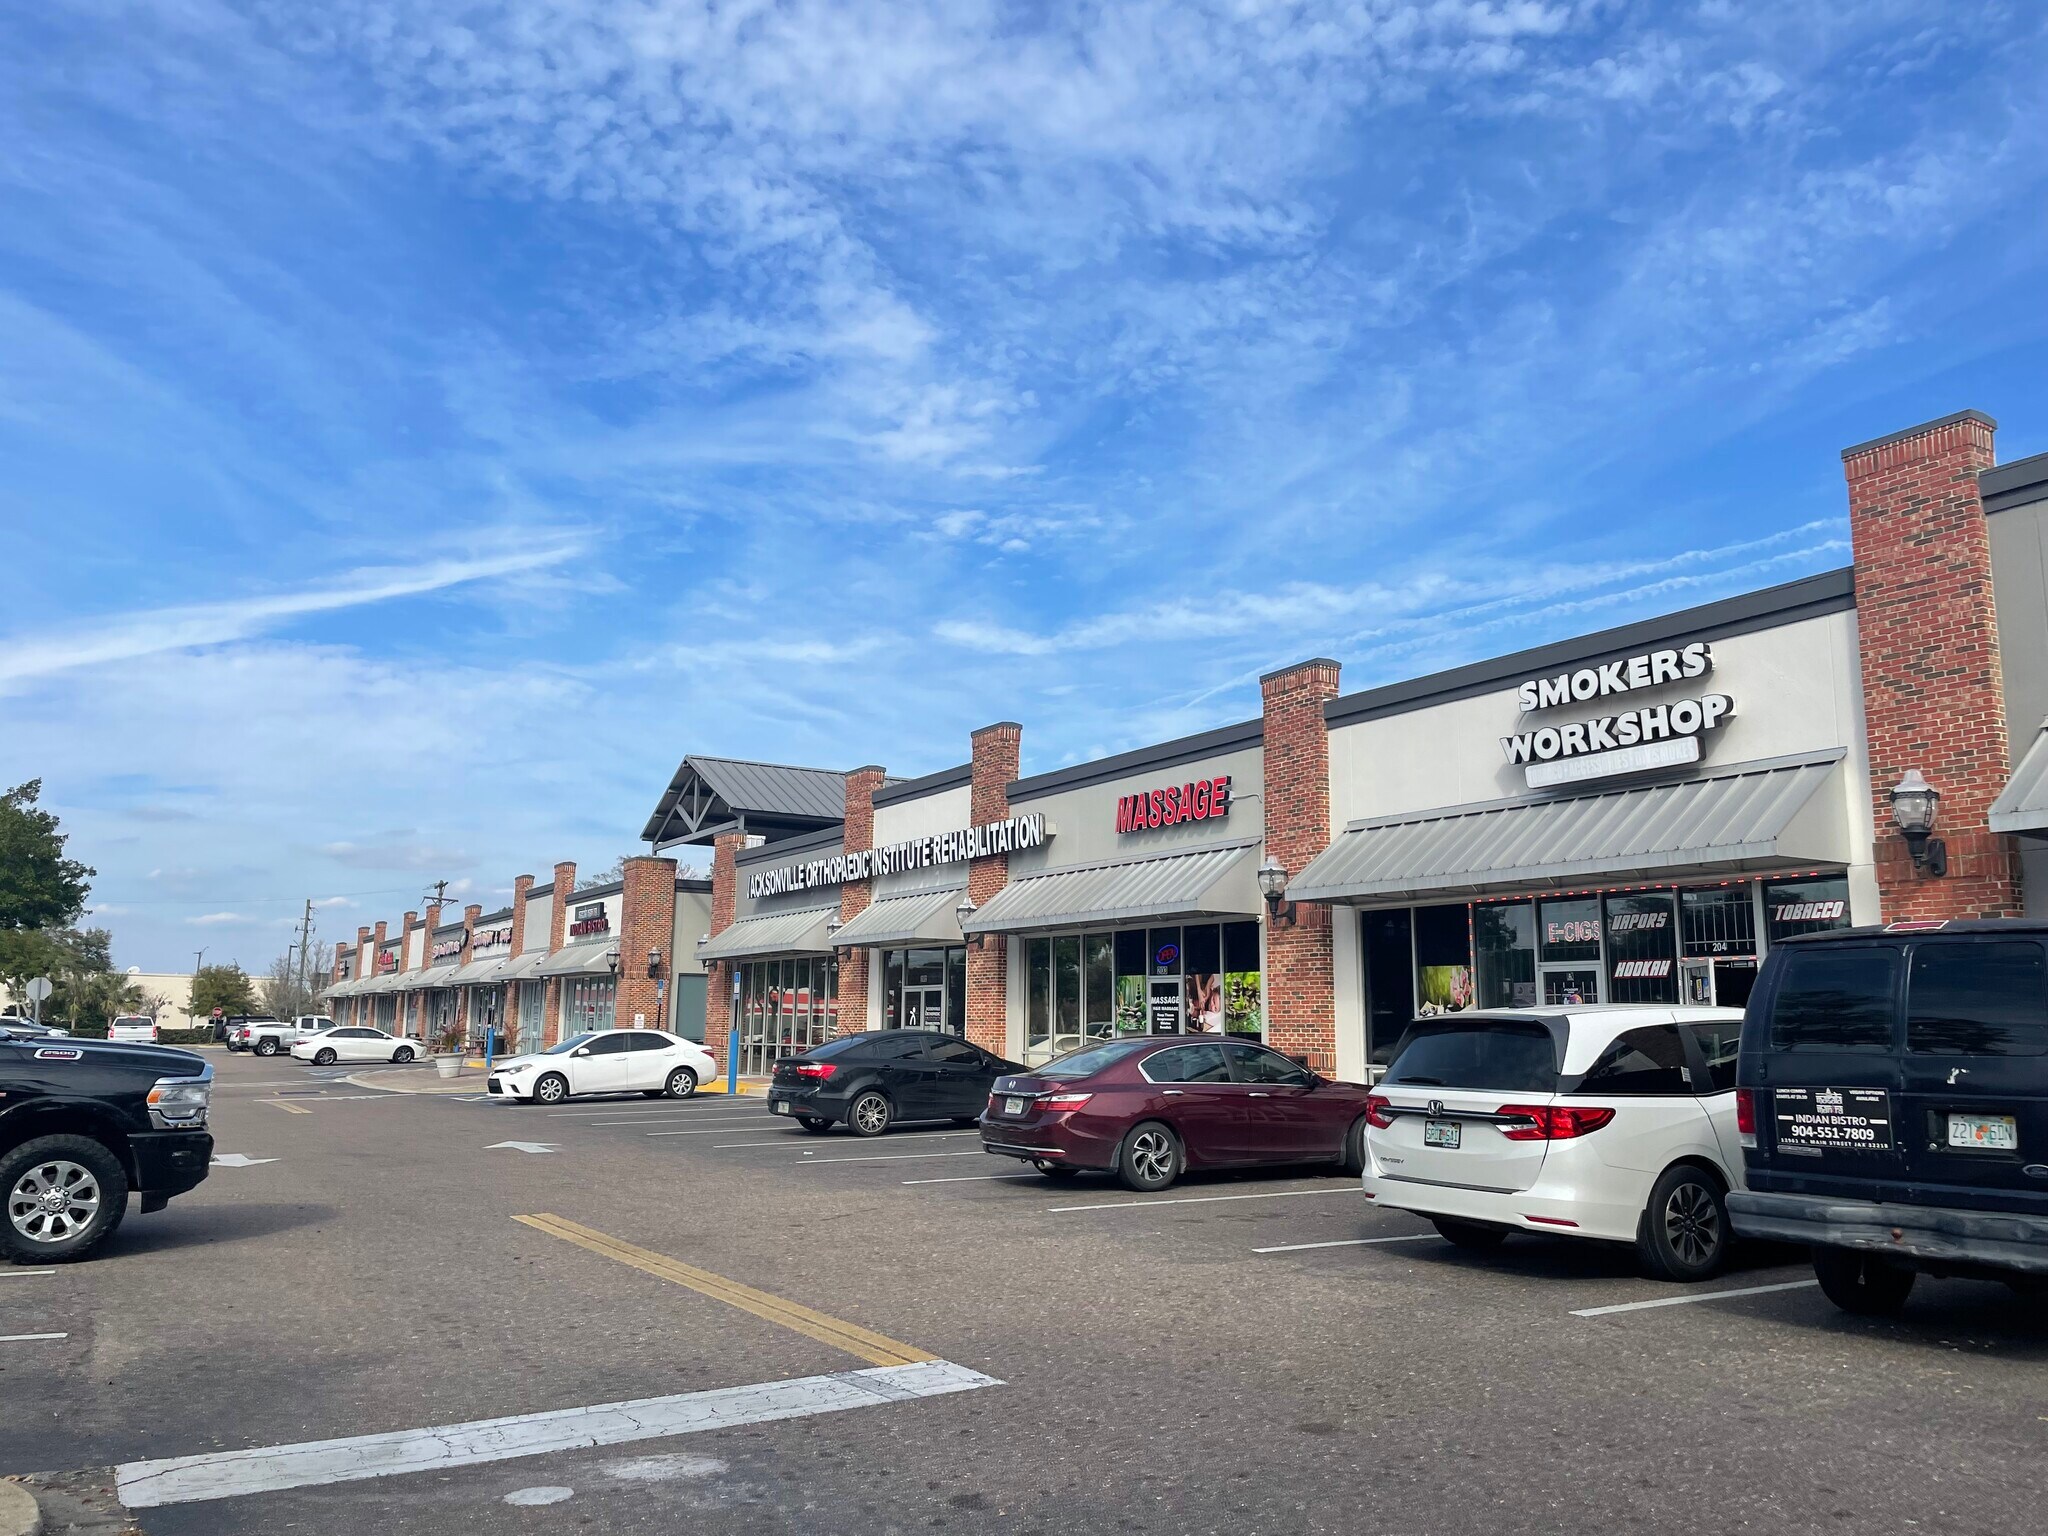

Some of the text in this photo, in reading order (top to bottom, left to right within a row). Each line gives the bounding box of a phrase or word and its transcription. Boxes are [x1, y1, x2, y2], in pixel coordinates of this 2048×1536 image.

[1518, 642, 1709, 712] SMOKERS
[1499, 693, 1731, 765] WORKSHOP
[1115, 776, 1230, 834] MASSAGE
[747, 813, 1042, 899] JACKSONVILLE ORTHOPAEDIC INSTITUTE REHABILITATION
[1775, 901, 1844, 921] TOBACCO
[1611, 912, 1668, 930] VAPORS
[1548, 920, 1600, 943] E-CIGS
[1712, 942, 1727, 952] 204
[1614, 960, 1671, 978] HOOKAH
[1151, 996, 1180, 1004] MASSAGE
[1795, 1114, 1867, 1126] INDIAN BISTRO
[1791, 1125, 1874, 1140] 904-551-7809
[1952, 1122, 1973, 1139] Z21
